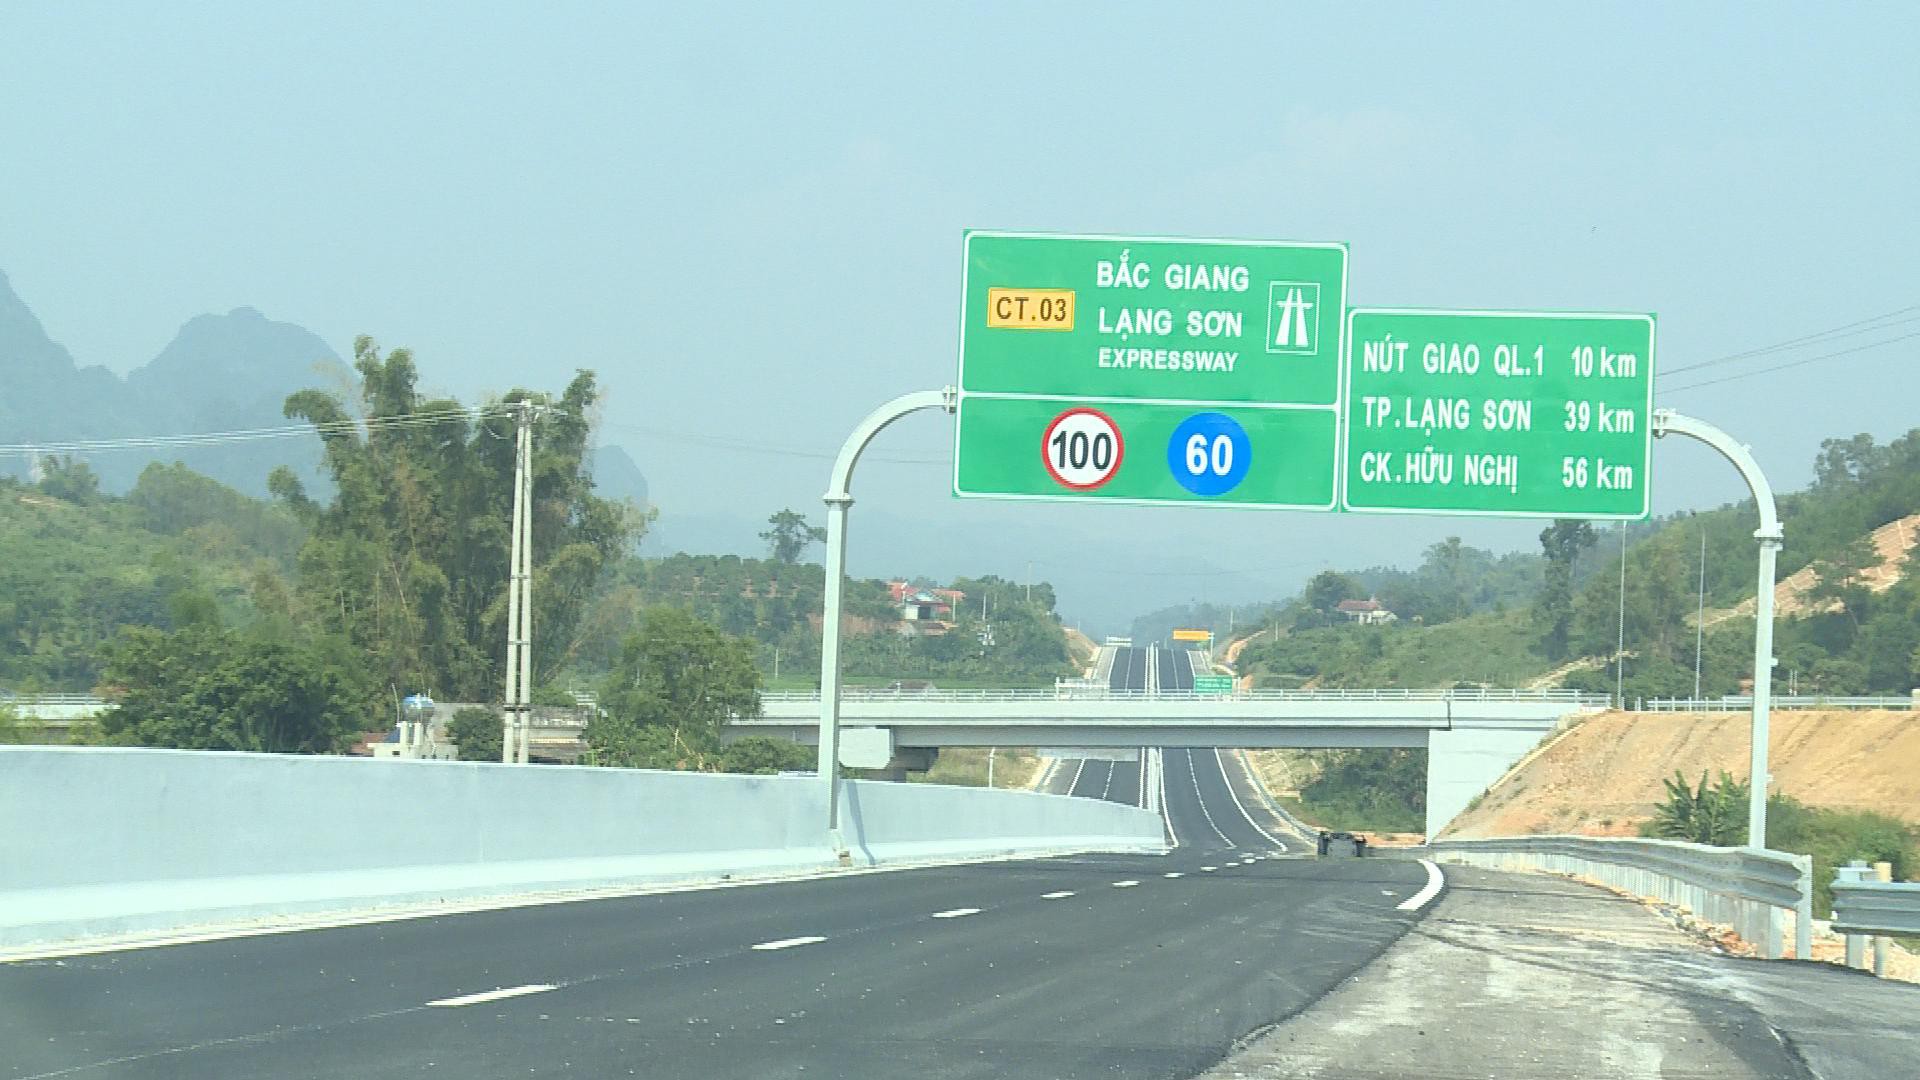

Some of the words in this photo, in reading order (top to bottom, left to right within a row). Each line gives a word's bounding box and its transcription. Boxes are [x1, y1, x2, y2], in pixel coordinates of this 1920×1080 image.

[1096, 248, 1151, 289] BẮC
[1165, 264, 1249, 292] GIANG
[996, 296, 1067, 322] CT.03
[1099, 307, 1172, 340] LẠNG
[1186, 310, 1243, 337] SƠN
[1098, 348, 1238, 372] EXPRESSWAY
[1363, 332, 1408, 373] NÚT
[1423, 343, 1480, 374] GIAO
[1494, 344, 1544, 378] QL.1
[1571, 346, 1593, 377] 10
[1600, 348, 1636, 378] km
[1483, 399, 1531, 431] SƠN
[1564, 401, 1591, 433] 39
[1598, 403, 1634, 434] km
[1052, 430, 1112, 471] 100
[1185, 433, 1233, 476] 60
[1464, 455, 1518, 493] NGHỊ
[1562, 456, 1589, 488] 56
[1596, 458, 1633, 490] km
